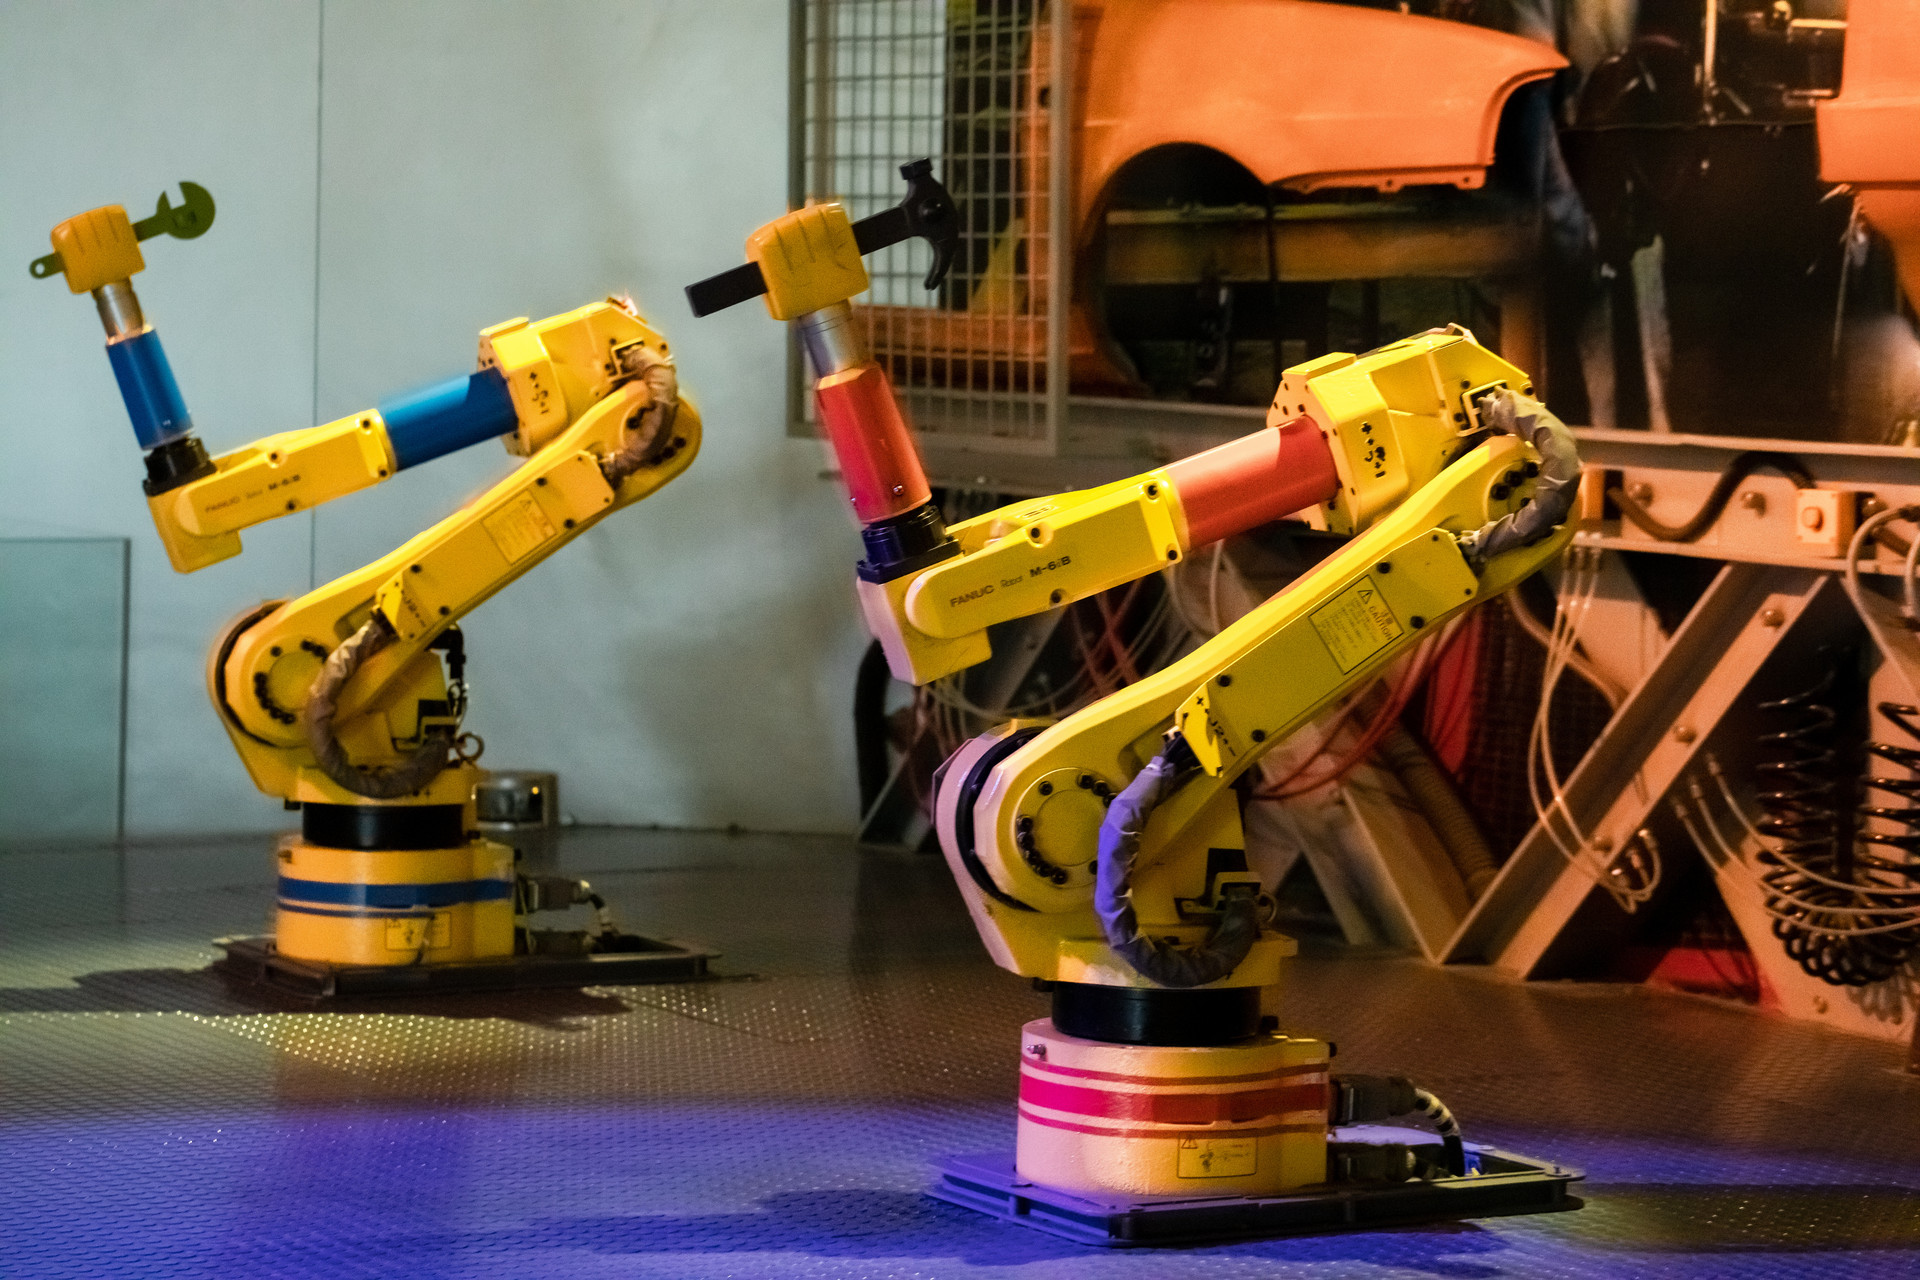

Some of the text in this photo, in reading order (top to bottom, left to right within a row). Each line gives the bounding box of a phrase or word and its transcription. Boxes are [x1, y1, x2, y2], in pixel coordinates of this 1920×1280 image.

[950, 584, 995, 607] FANUC
[1001, 574, 1025, 588] Robot
[1369, 605, 1393, 641] CAUTION
